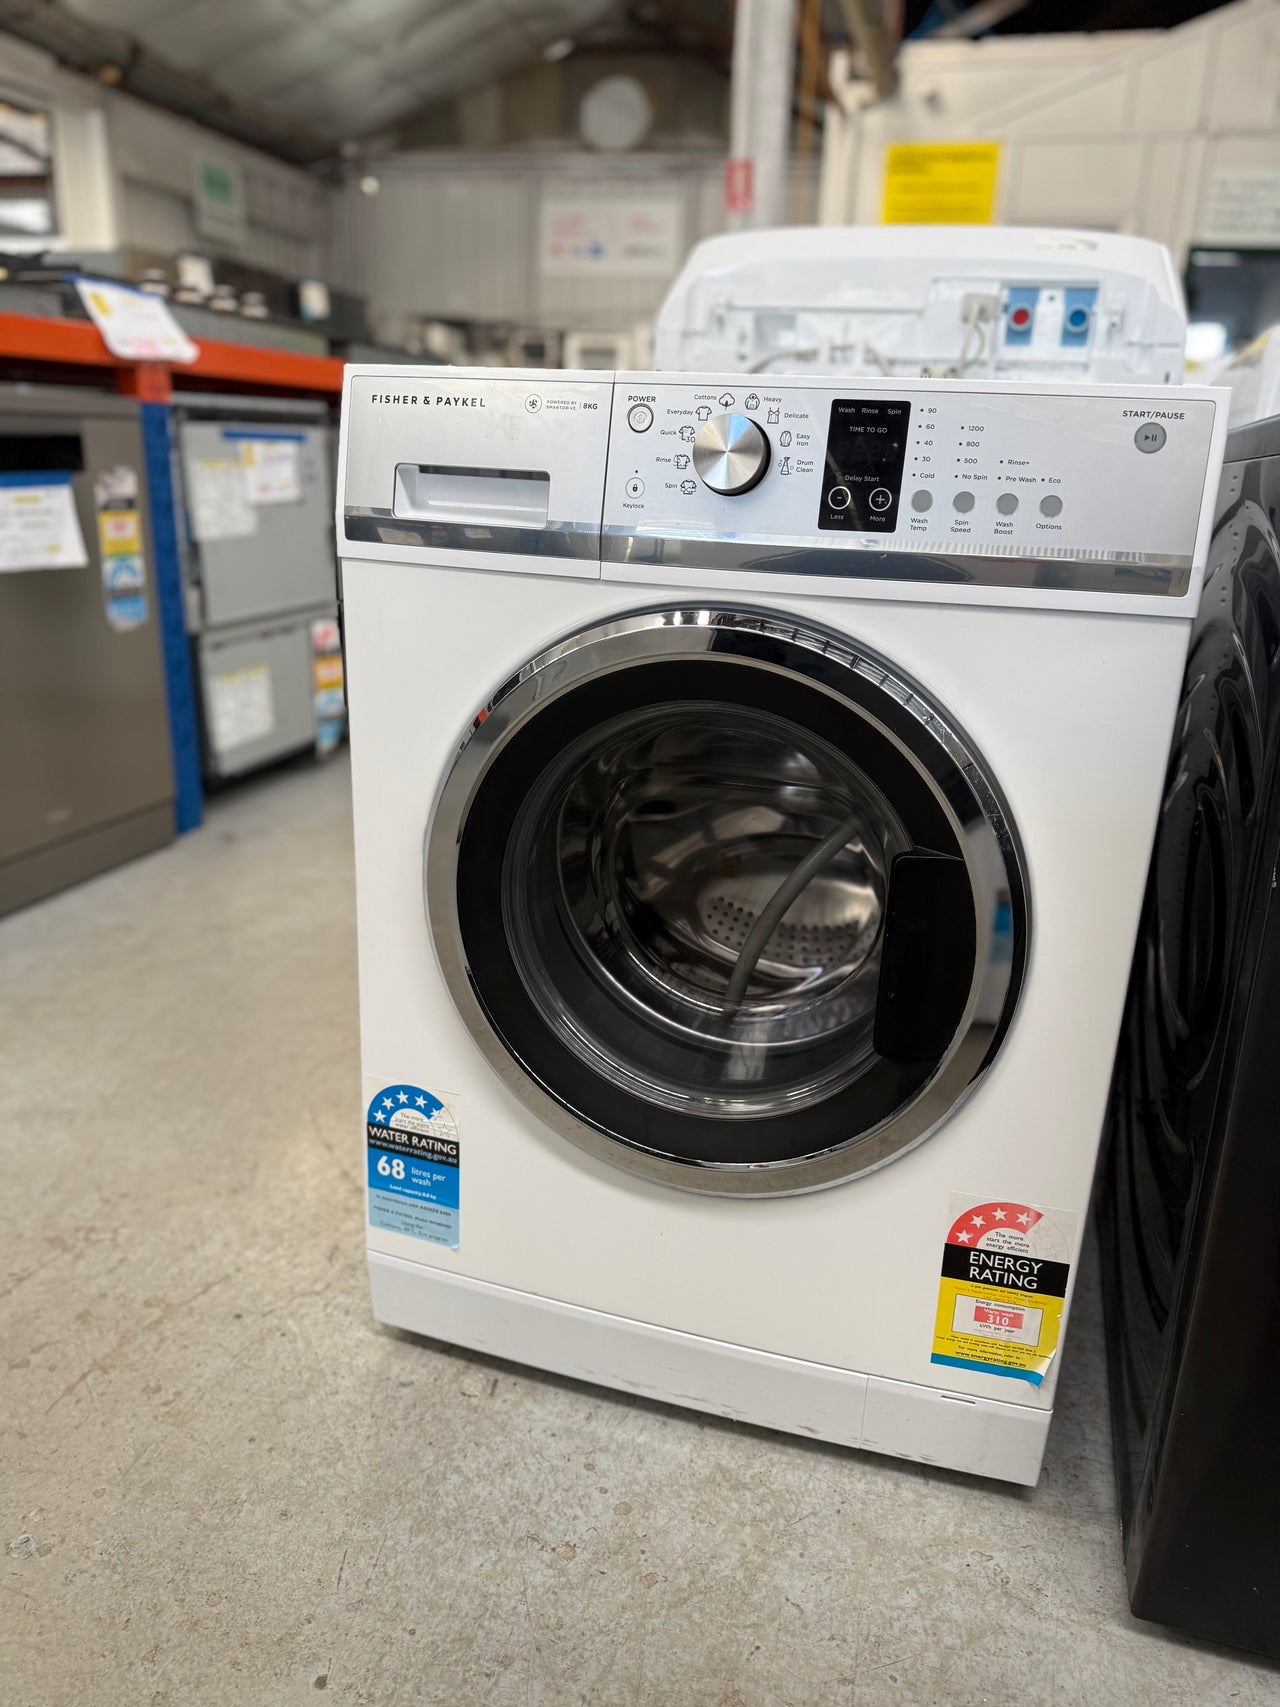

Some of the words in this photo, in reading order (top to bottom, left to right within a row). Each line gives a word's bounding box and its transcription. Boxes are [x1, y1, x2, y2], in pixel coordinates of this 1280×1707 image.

[371, 394, 418, 405] FISHER
[423, 396, 431, 405] &
[436, 397, 486, 408] PAYKEL
[627, 395, 657, 403] POWER
[582, 402, 598, 410] 8KG
[861, 407, 879, 415] Rinse
[887, 408, 902, 416] Spin
[1122, 410, 1186, 420] START/PAUSE
[369, 1126, 409, 1144] WATER
[412, 1136, 457, 1155] RATING
[369, 1139, 458, 1163] www.waterrating.gov.au
[377, 1155, 406, 1180] 68
[411, 1167, 431, 1178] litres
[432, 1173, 446, 1182] per
[411, 1177, 432, 1187] wash
[402, 1187, 421, 1197] capacity
[1007, 1246, 1029, 1254] efficient
[969, 1251, 1043, 1275] ENERGY
[969, 1266, 1038, 1290] RATING
[994, 1302, 1026, 1312] consumption
[987, 1314, 1009, 1326] 310
